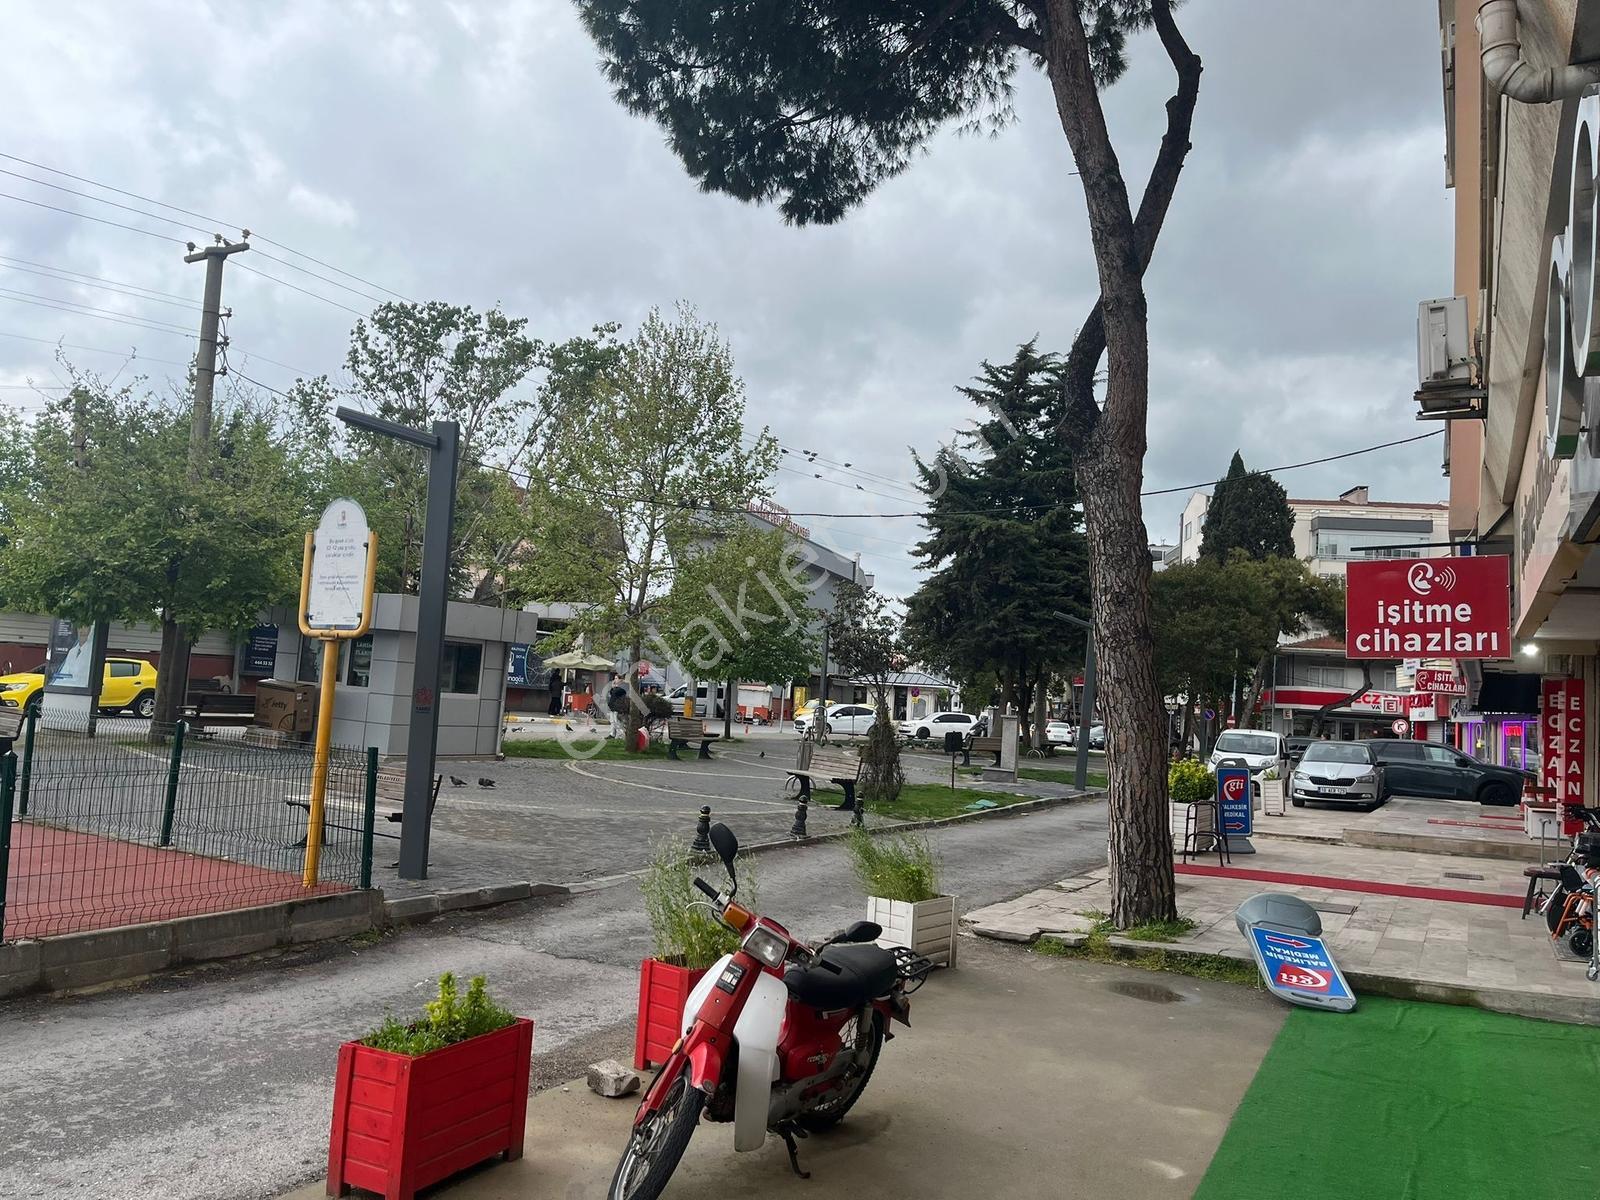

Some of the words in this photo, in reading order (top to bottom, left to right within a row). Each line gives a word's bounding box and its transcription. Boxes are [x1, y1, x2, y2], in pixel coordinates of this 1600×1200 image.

[1378, 599, 1472, 626] işitme
[1355, 627, 1498, 652] cihazları
[1434, 671, 1454, 683] İŞİT
[1427, 681, 1465, 693] CİHAZLARI
[1386, 702, 1395, 711] E
